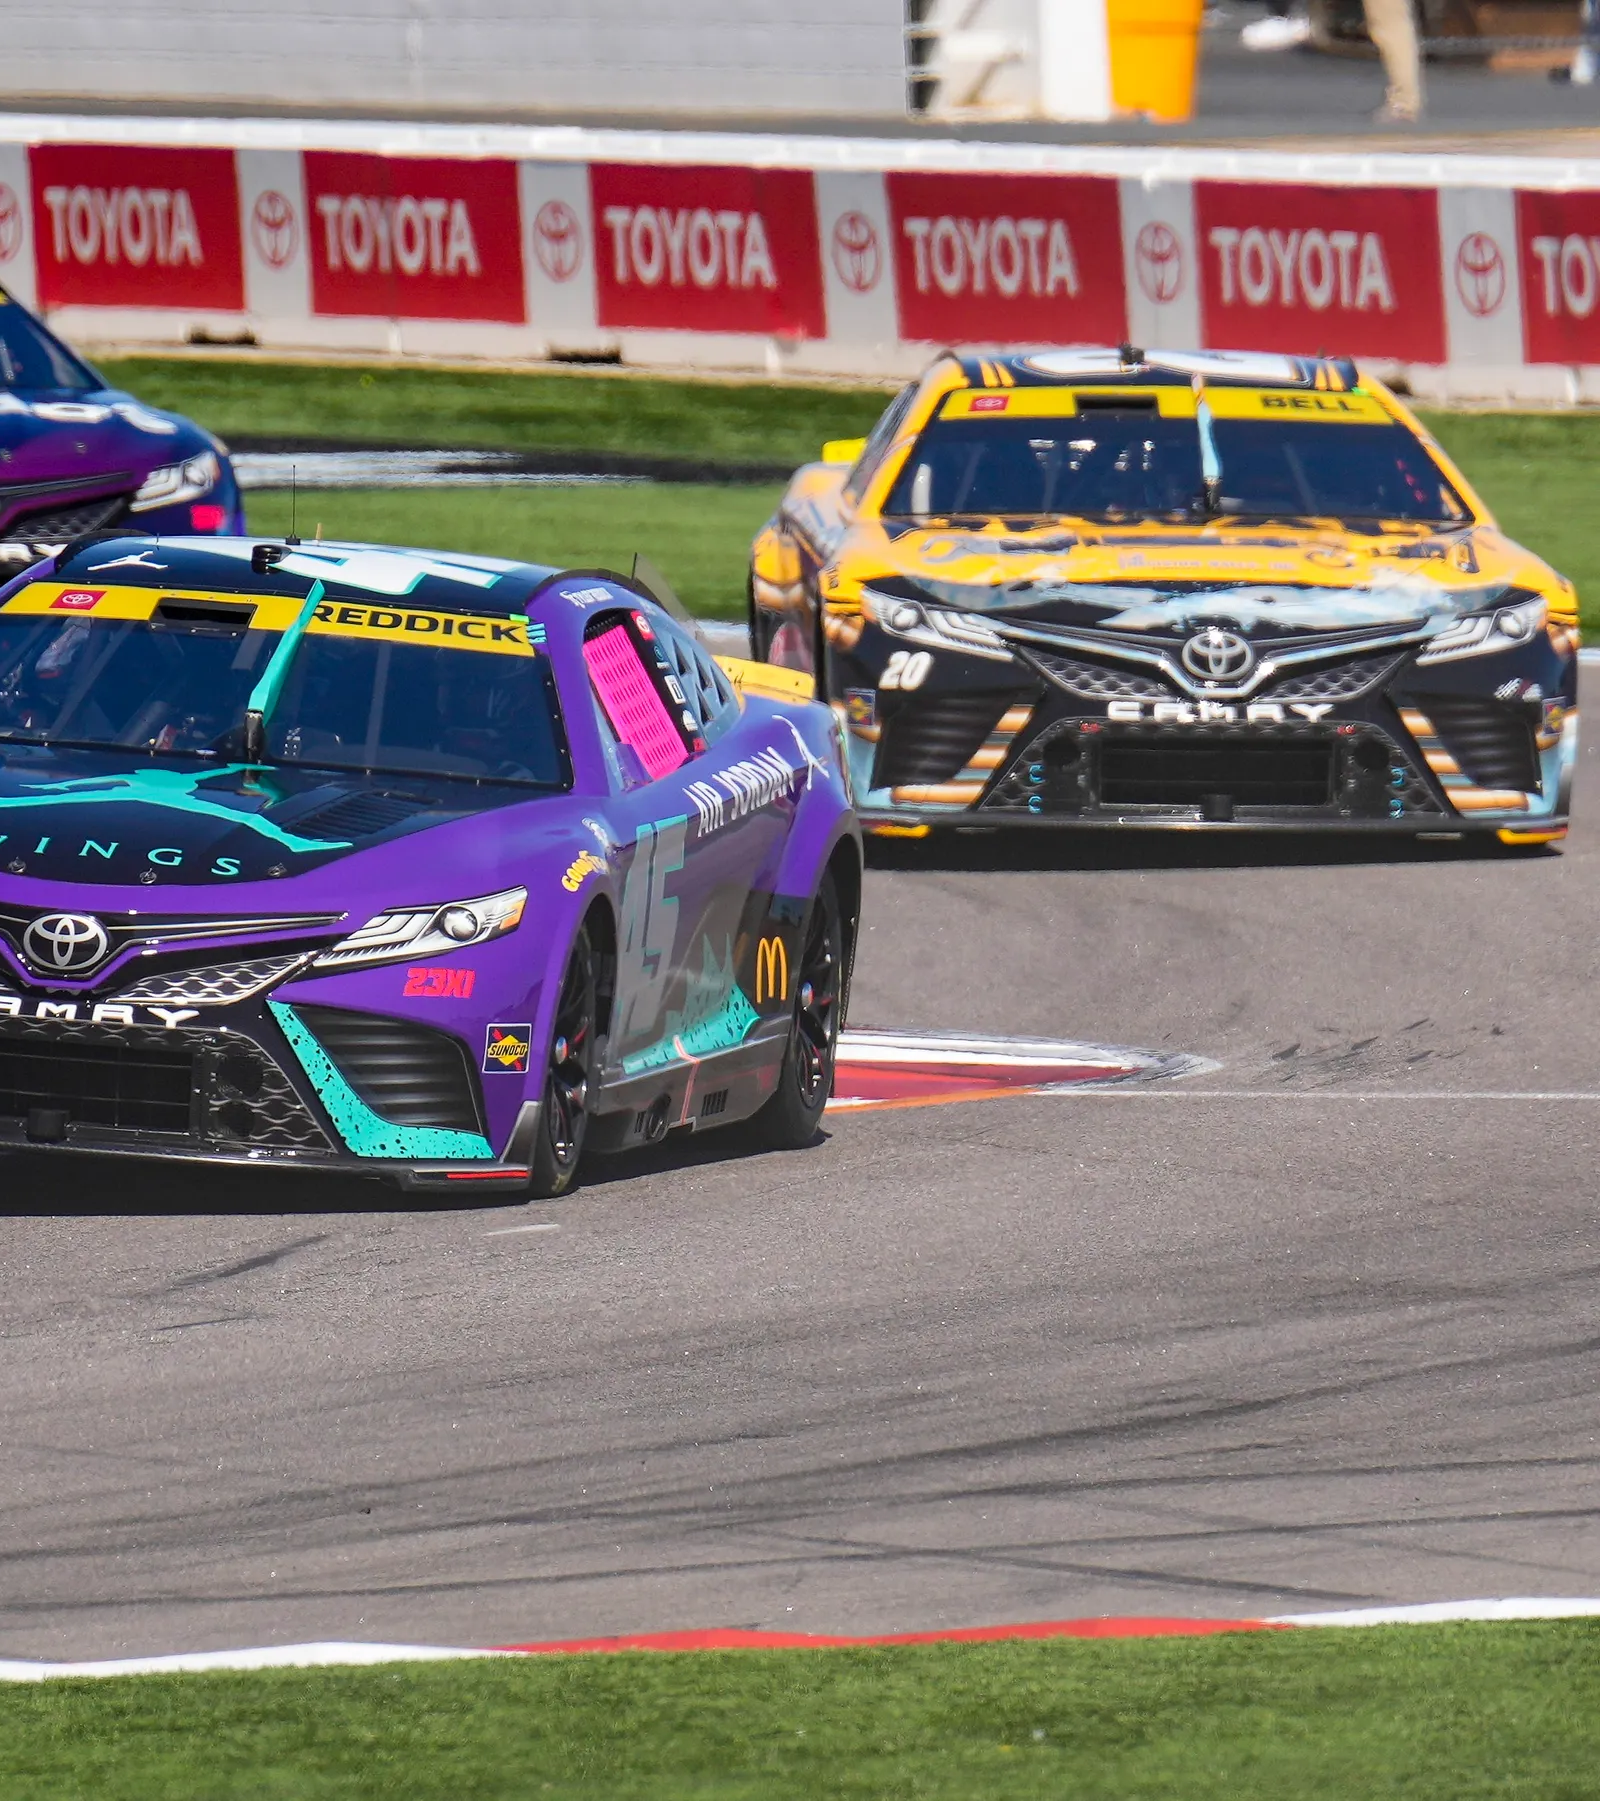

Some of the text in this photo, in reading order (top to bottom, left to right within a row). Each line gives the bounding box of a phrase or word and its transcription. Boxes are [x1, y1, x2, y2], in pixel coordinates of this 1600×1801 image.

[43, 185, 204, 266] TOYOTA
[315, 194, 482, 277] TOYOTA
[605, 204, 778, 289] TOYOTA
[903, 214, 1081, 298] TOYOTA
[1209, 225, 1395, 314] TOYOTA
[1261, 395, 1365, 412] BELL
[311, 604, 525, 644] REDDICK
[878, 650, 935, 691] 20
[1107, 700, 1334, 724] CAMRY
[682, 780, 725, 838] AIR
[711, 746, 795, 821] JORDAN
[616, 814, 688, 1037] 45
[403, 967, 476, 999] 23XI
[489, 1044, 527, 1057] SUNOCO
